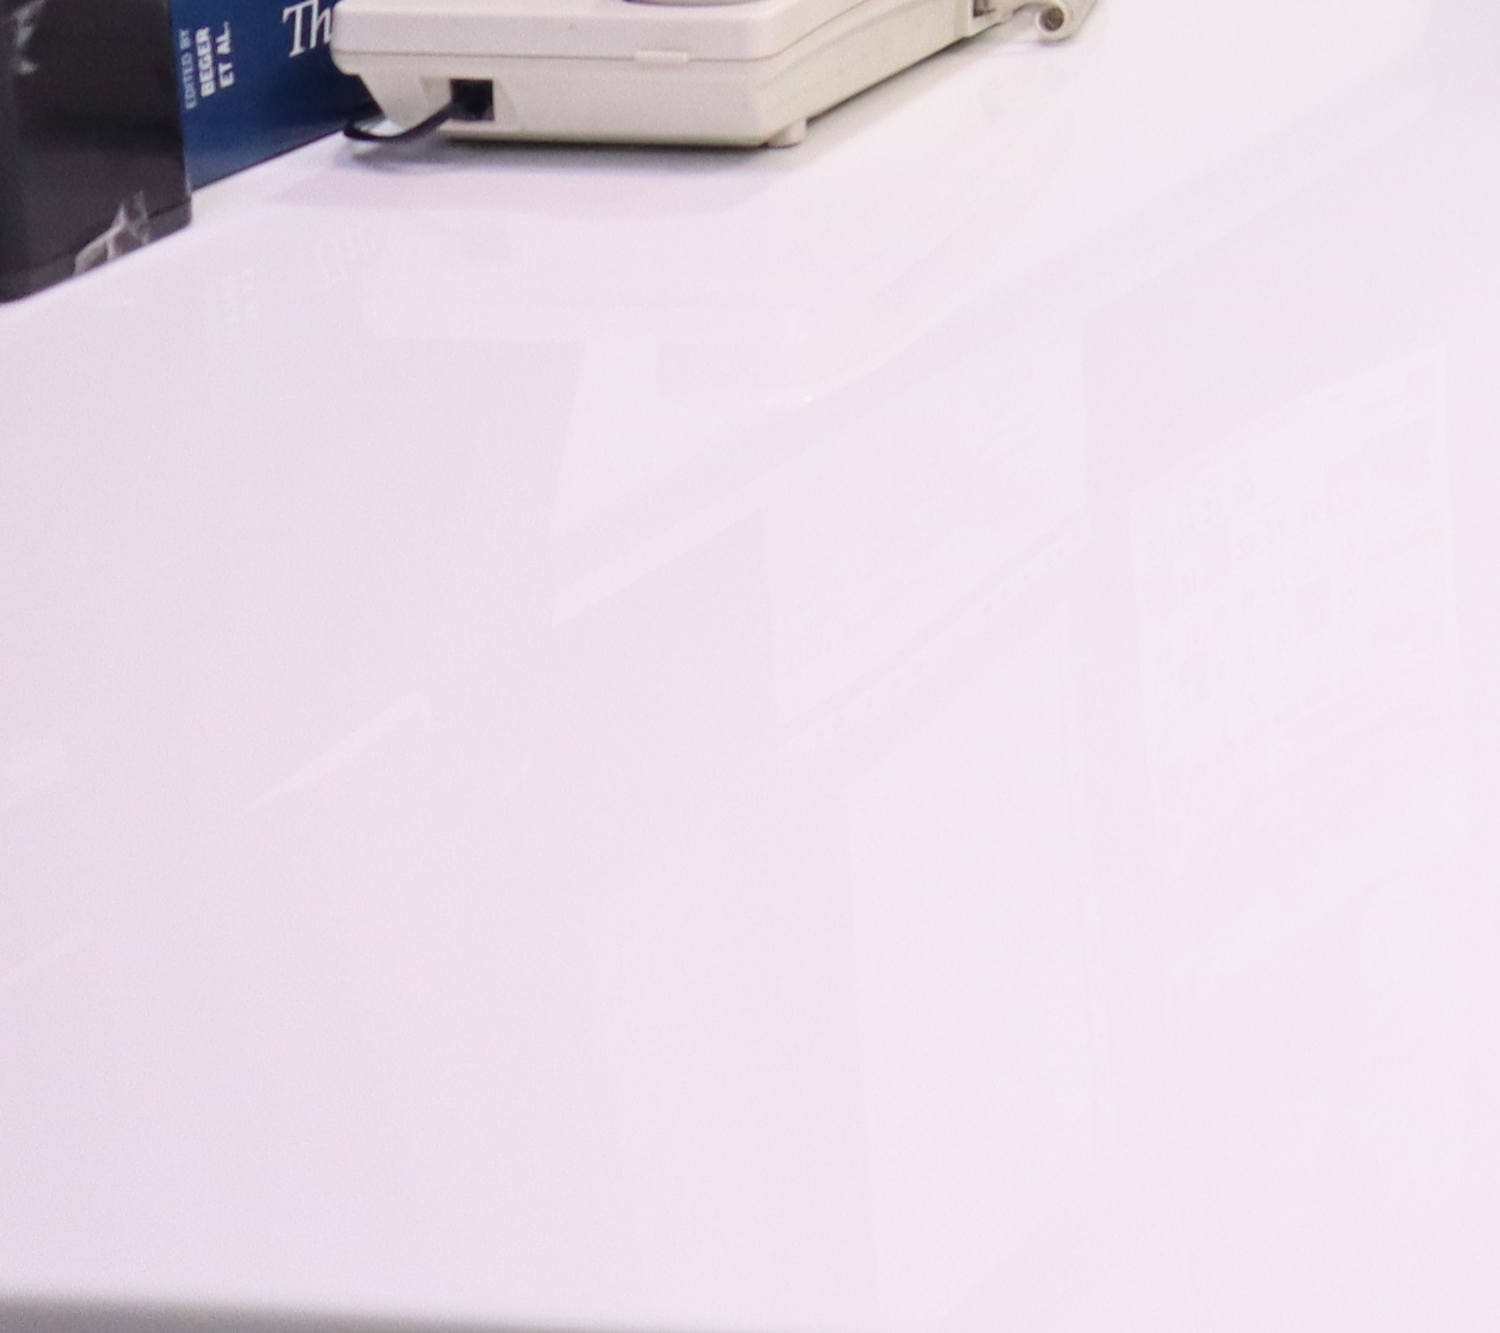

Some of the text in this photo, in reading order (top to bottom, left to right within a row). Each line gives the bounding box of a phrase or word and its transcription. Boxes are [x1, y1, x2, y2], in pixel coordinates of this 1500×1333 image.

[178, 29, 198, 110] EDITED BY
[195, 27, 216, 98] BEGER
[215, 21, 235, 88] ET AL.
